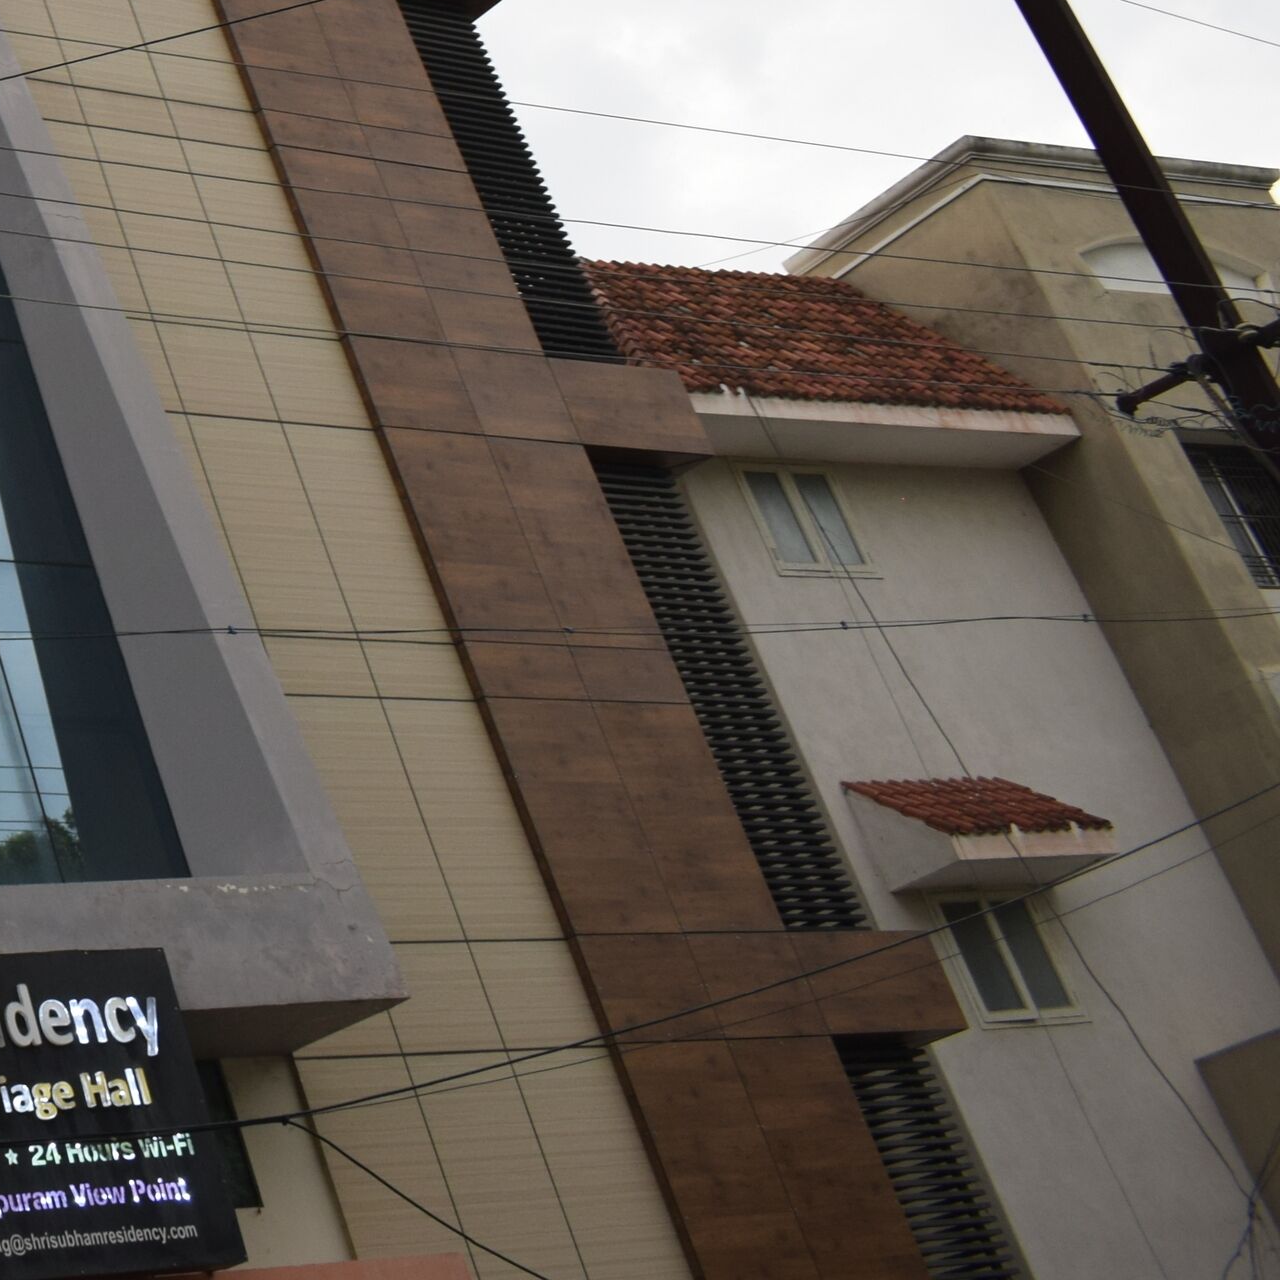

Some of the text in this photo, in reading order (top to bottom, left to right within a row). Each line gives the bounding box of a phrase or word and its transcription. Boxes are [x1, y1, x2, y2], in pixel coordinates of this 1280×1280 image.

[79, 1068, 152, 1108] Hall
[28, 1133, 194, 1166] 24 Hours Wi-Fi
[70, 1183, 126, 1209] View
[129, 1177, 192, 1203] Point
